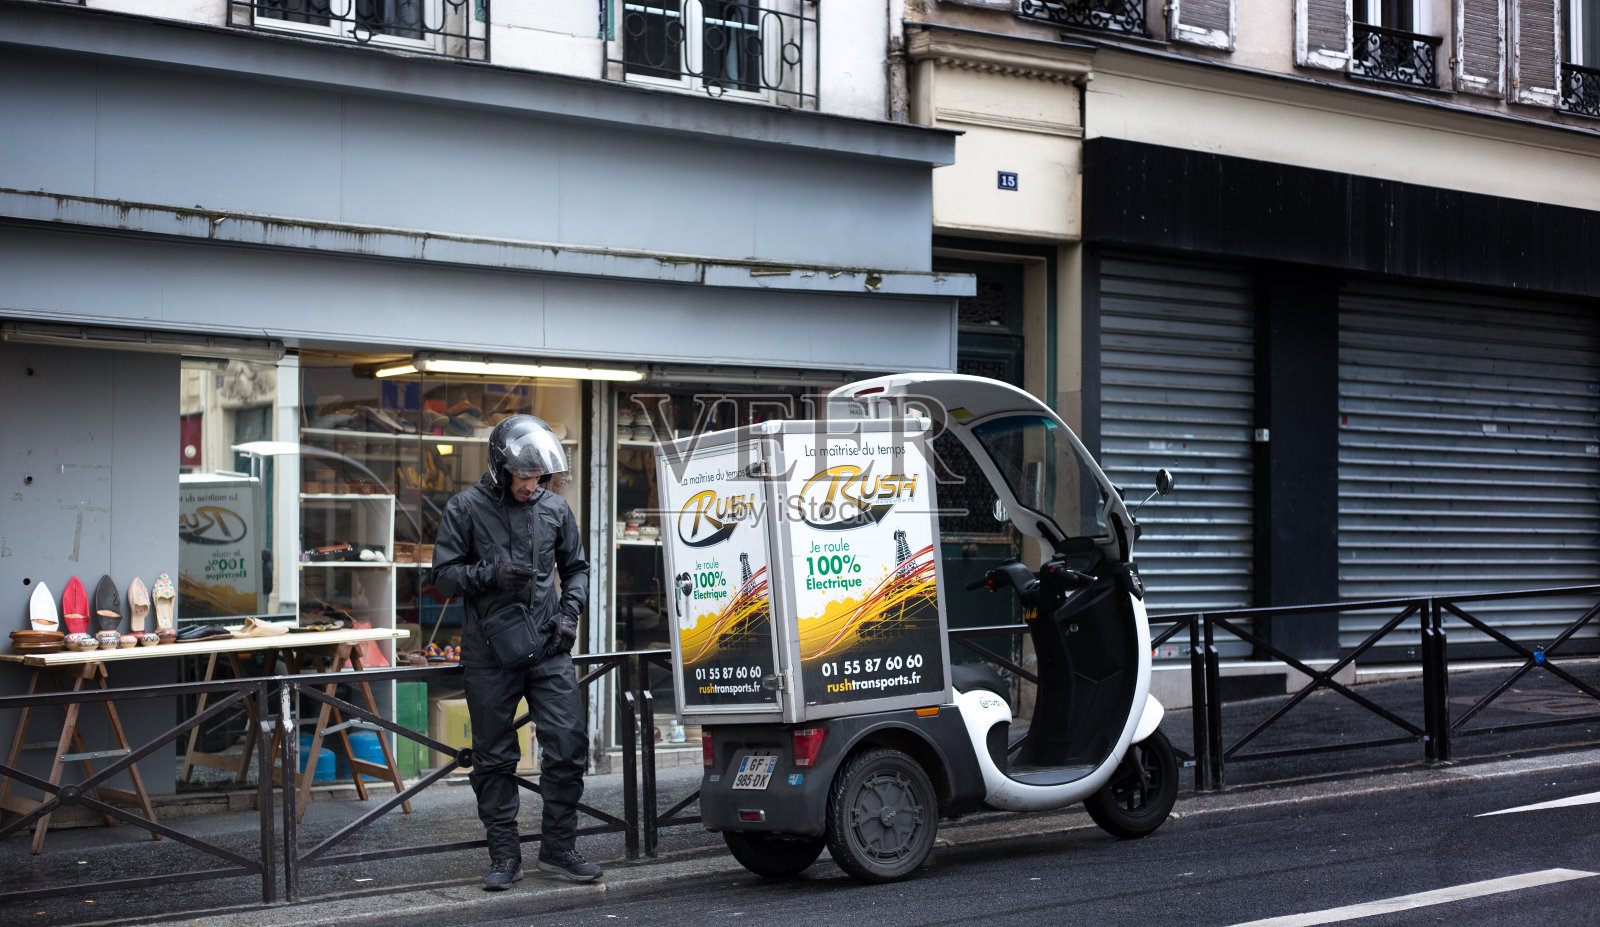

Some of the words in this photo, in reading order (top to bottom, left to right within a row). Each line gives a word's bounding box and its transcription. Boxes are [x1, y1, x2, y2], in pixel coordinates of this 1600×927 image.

[1001, 175, 1016, 187] 15
[805, 444, 816, 457] La
[820, 443, 859, 456] maîtrise
[862, 442, 875, 455] du
[877, 444, 906, 458] temps
[681, 477, 689, 486] La
[716, 468, 725, 481] du
[725, 469, 746, 480] temps
[798, 465, 918, 531] RUSH
[678, 490, 755, 548] RUSH
[810, 540, 821, 553] Je
[824, 537, 850, 553] roule
[695, 560, 702, 570] Je
[703, 557, 719, 570] roule
[806, 554, 861, 576] 100%
[694, 571, 727, 590] 100%
[806, 575, 862, 591] Électrique
[695, 668, 706, 680] 01
[709, 667, 720, 680] 55
[722, 667, 734, 679] 87
[736, 666, 748, 679] 60
[749, 665, 762, 678] 60
[821, 662, 838, 677] 01
[844, 660, 861, 675] 55
[865, 658, 881, 673] 87
[886, 655, 903, 671] 60
[906, 653, 923, 669] 60
[699, 681, 761, 695] rushtransports.fr
[827, 671, 922, 693] rushtransports.fr
